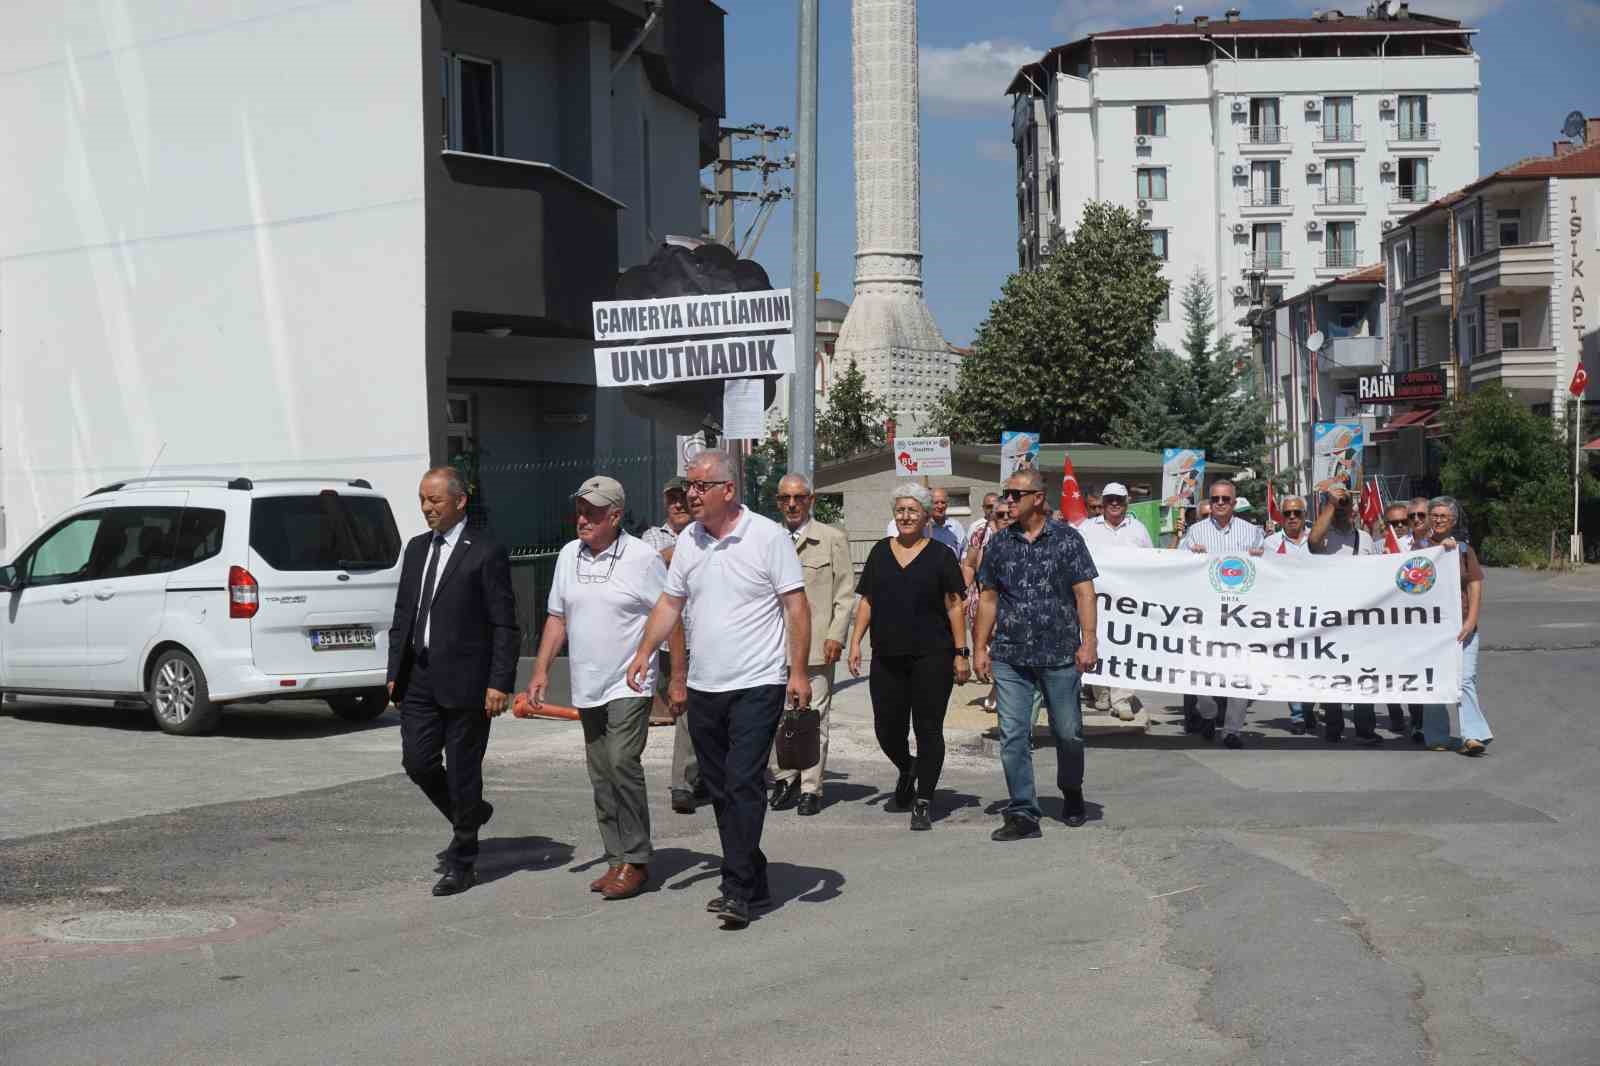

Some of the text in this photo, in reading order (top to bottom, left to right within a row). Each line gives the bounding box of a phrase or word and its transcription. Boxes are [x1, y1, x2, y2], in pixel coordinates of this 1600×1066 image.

[596, 295, 791, 338] ÇAMERYA KATLİAMINI
[610, 339, 777, 383] UNUTMADIK
[1220, 603, 1441, 628] Katliamını
[1107, 620, 1350, 664] Unutmadık,
